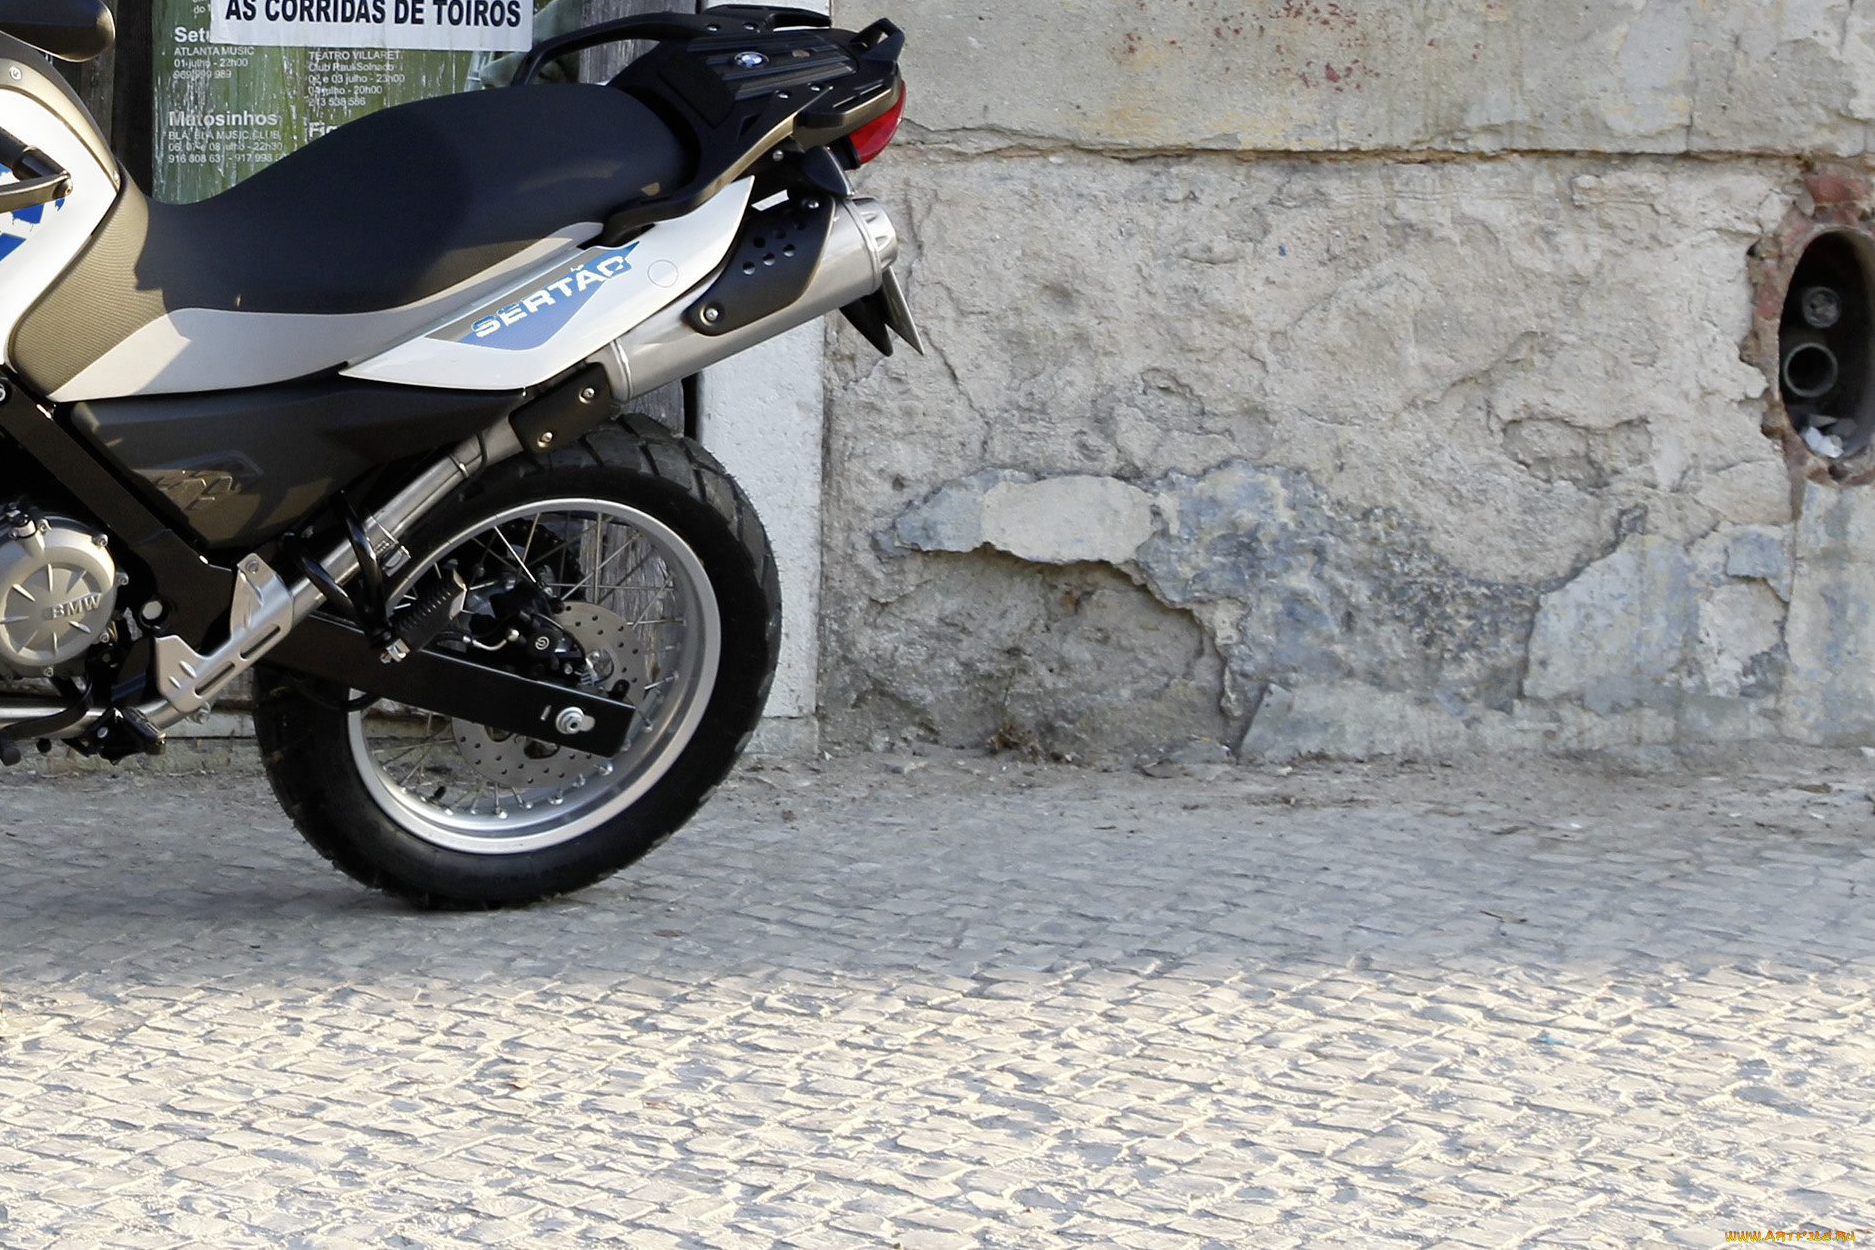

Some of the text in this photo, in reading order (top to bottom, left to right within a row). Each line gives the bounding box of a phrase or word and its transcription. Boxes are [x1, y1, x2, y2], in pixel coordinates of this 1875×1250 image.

[433, 0, 522, 28] TOIROS
[174, 47, 254, 56] ATLANTA MUSIC
[169, 111, 278, 126] Matosinhos
[470, 255, 629, 338] SERTÃO
[51, 593, 102, 618] BMW
